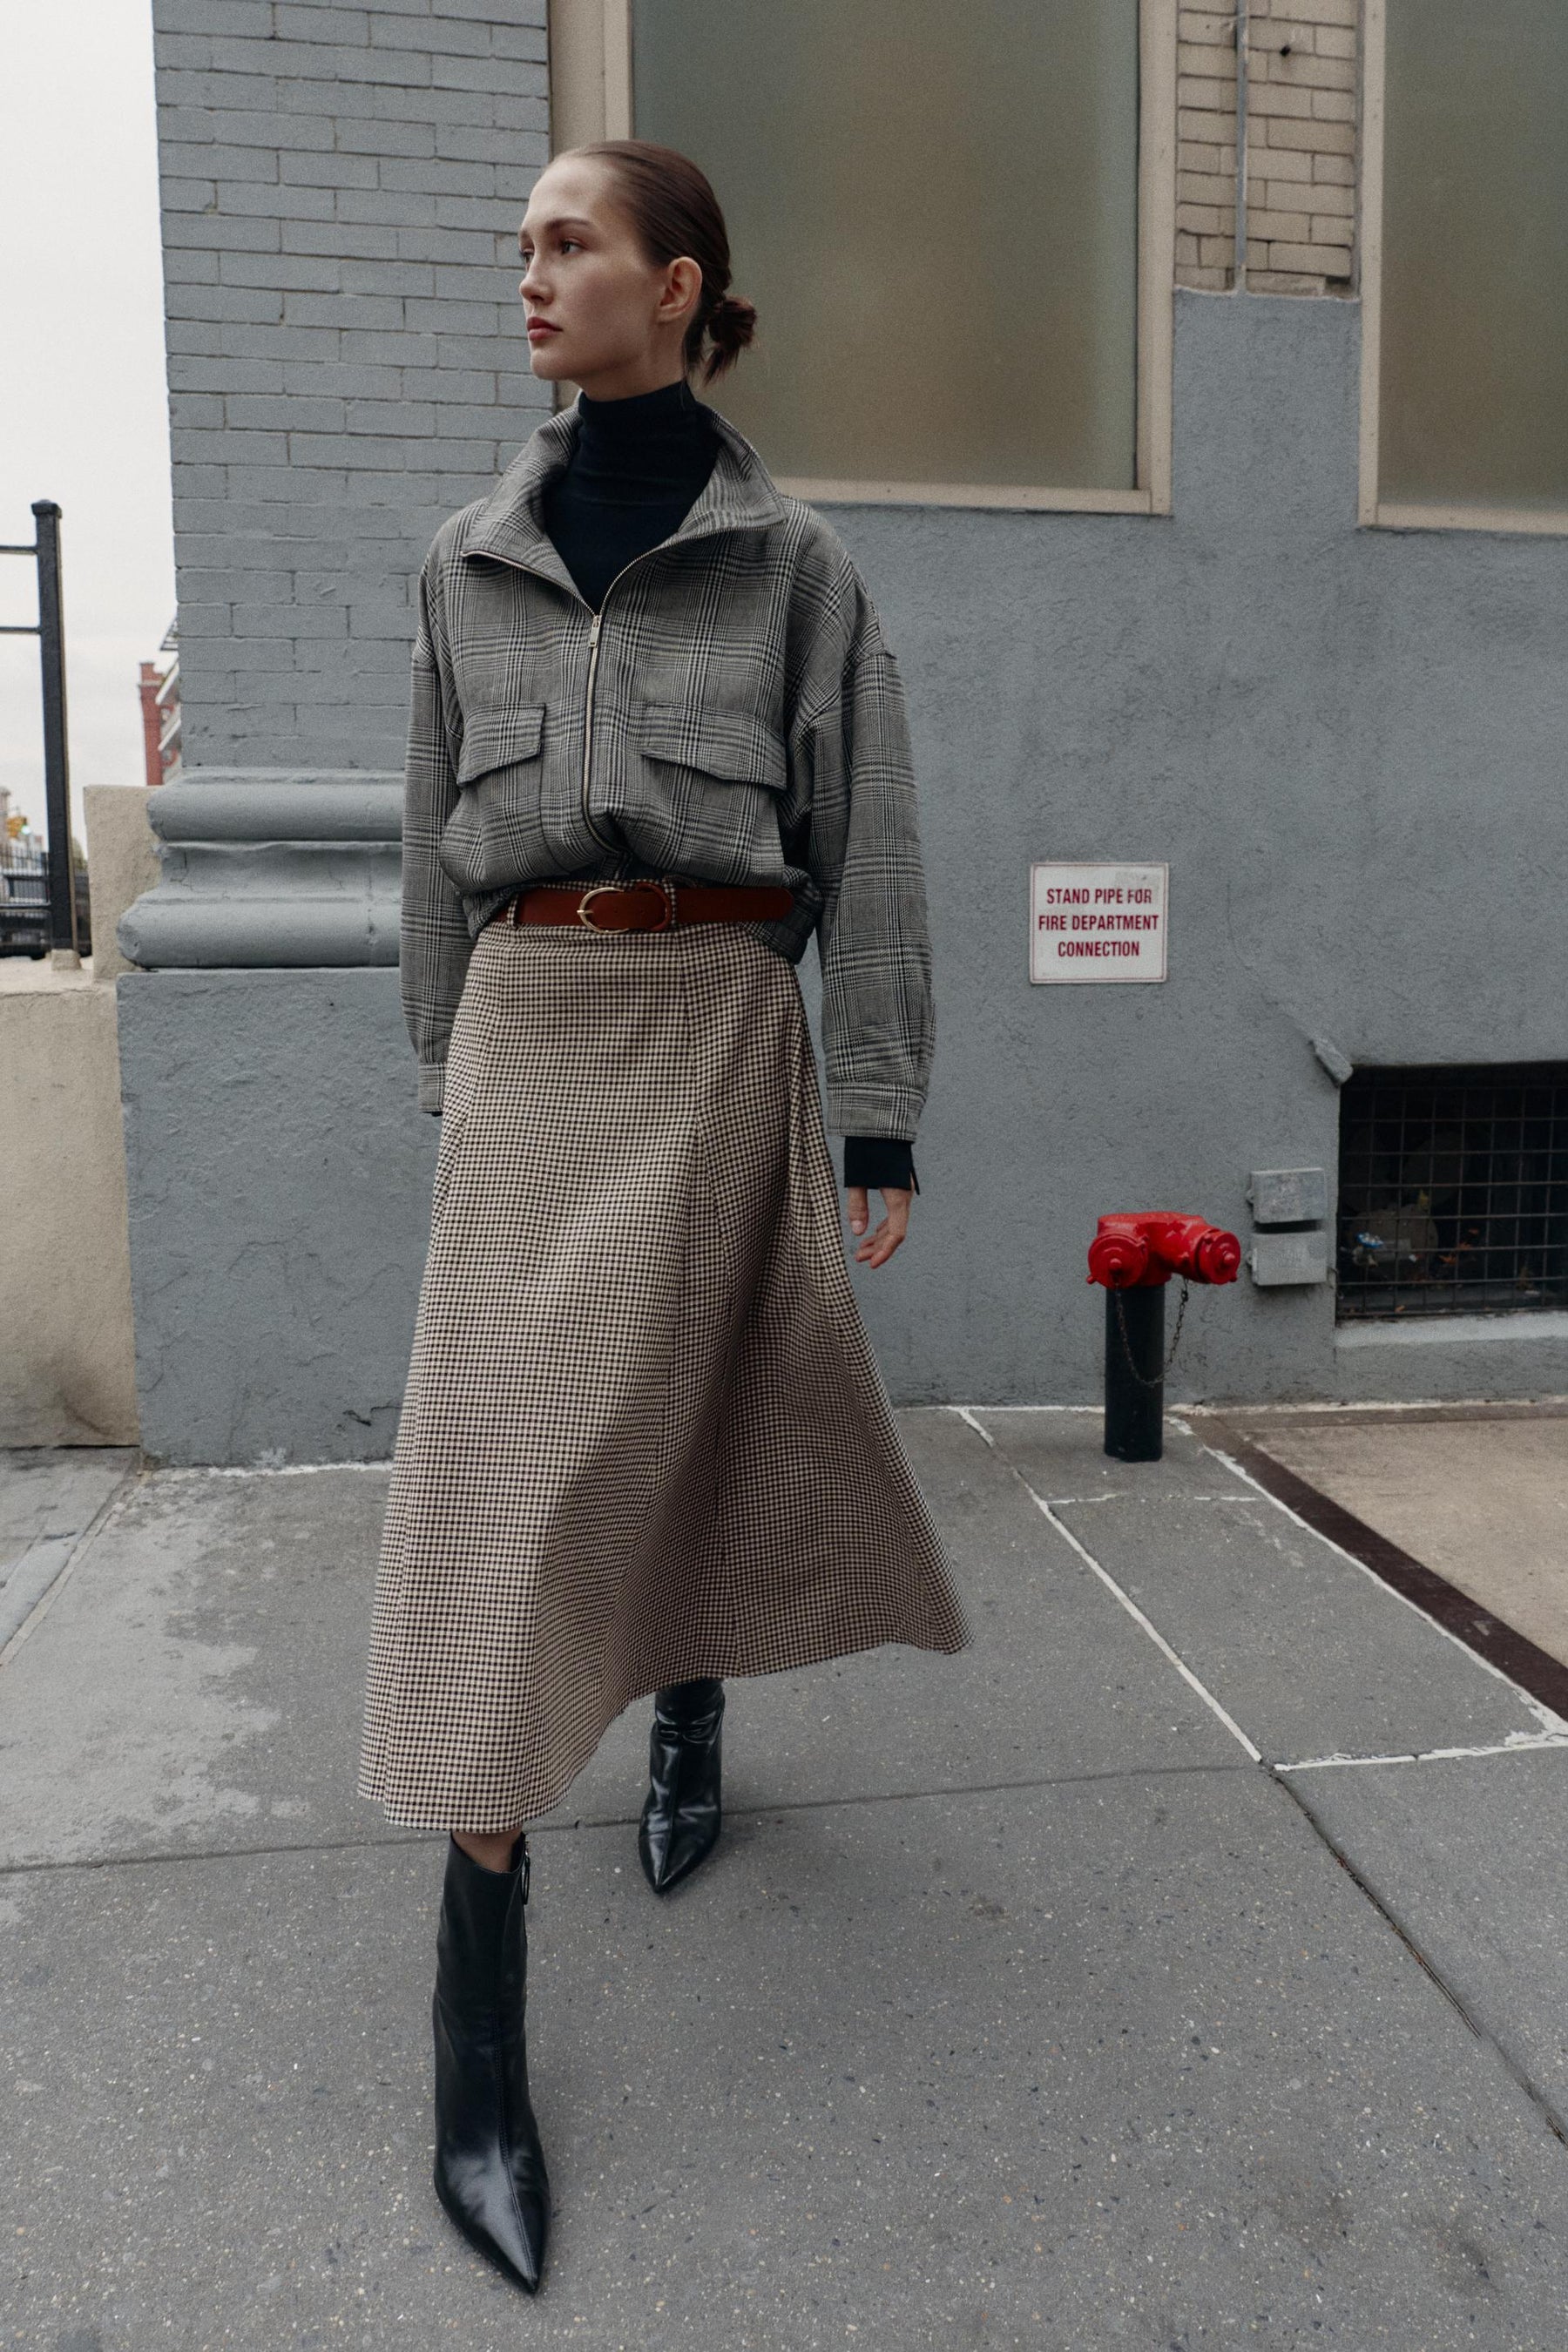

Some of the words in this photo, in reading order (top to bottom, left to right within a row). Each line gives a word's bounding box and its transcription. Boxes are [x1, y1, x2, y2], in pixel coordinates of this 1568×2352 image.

[1046, 889, 1090, 904] STAND
[1094, 889, 1123, 904] PIPE
[1127, 889, 1152, 904] FOR
[1038, 915, 1067, 930] FIRE
[1071, 915, 1159, 930] DEPARTMENT
[1058, 941, 1139, 956] CONNECTION
